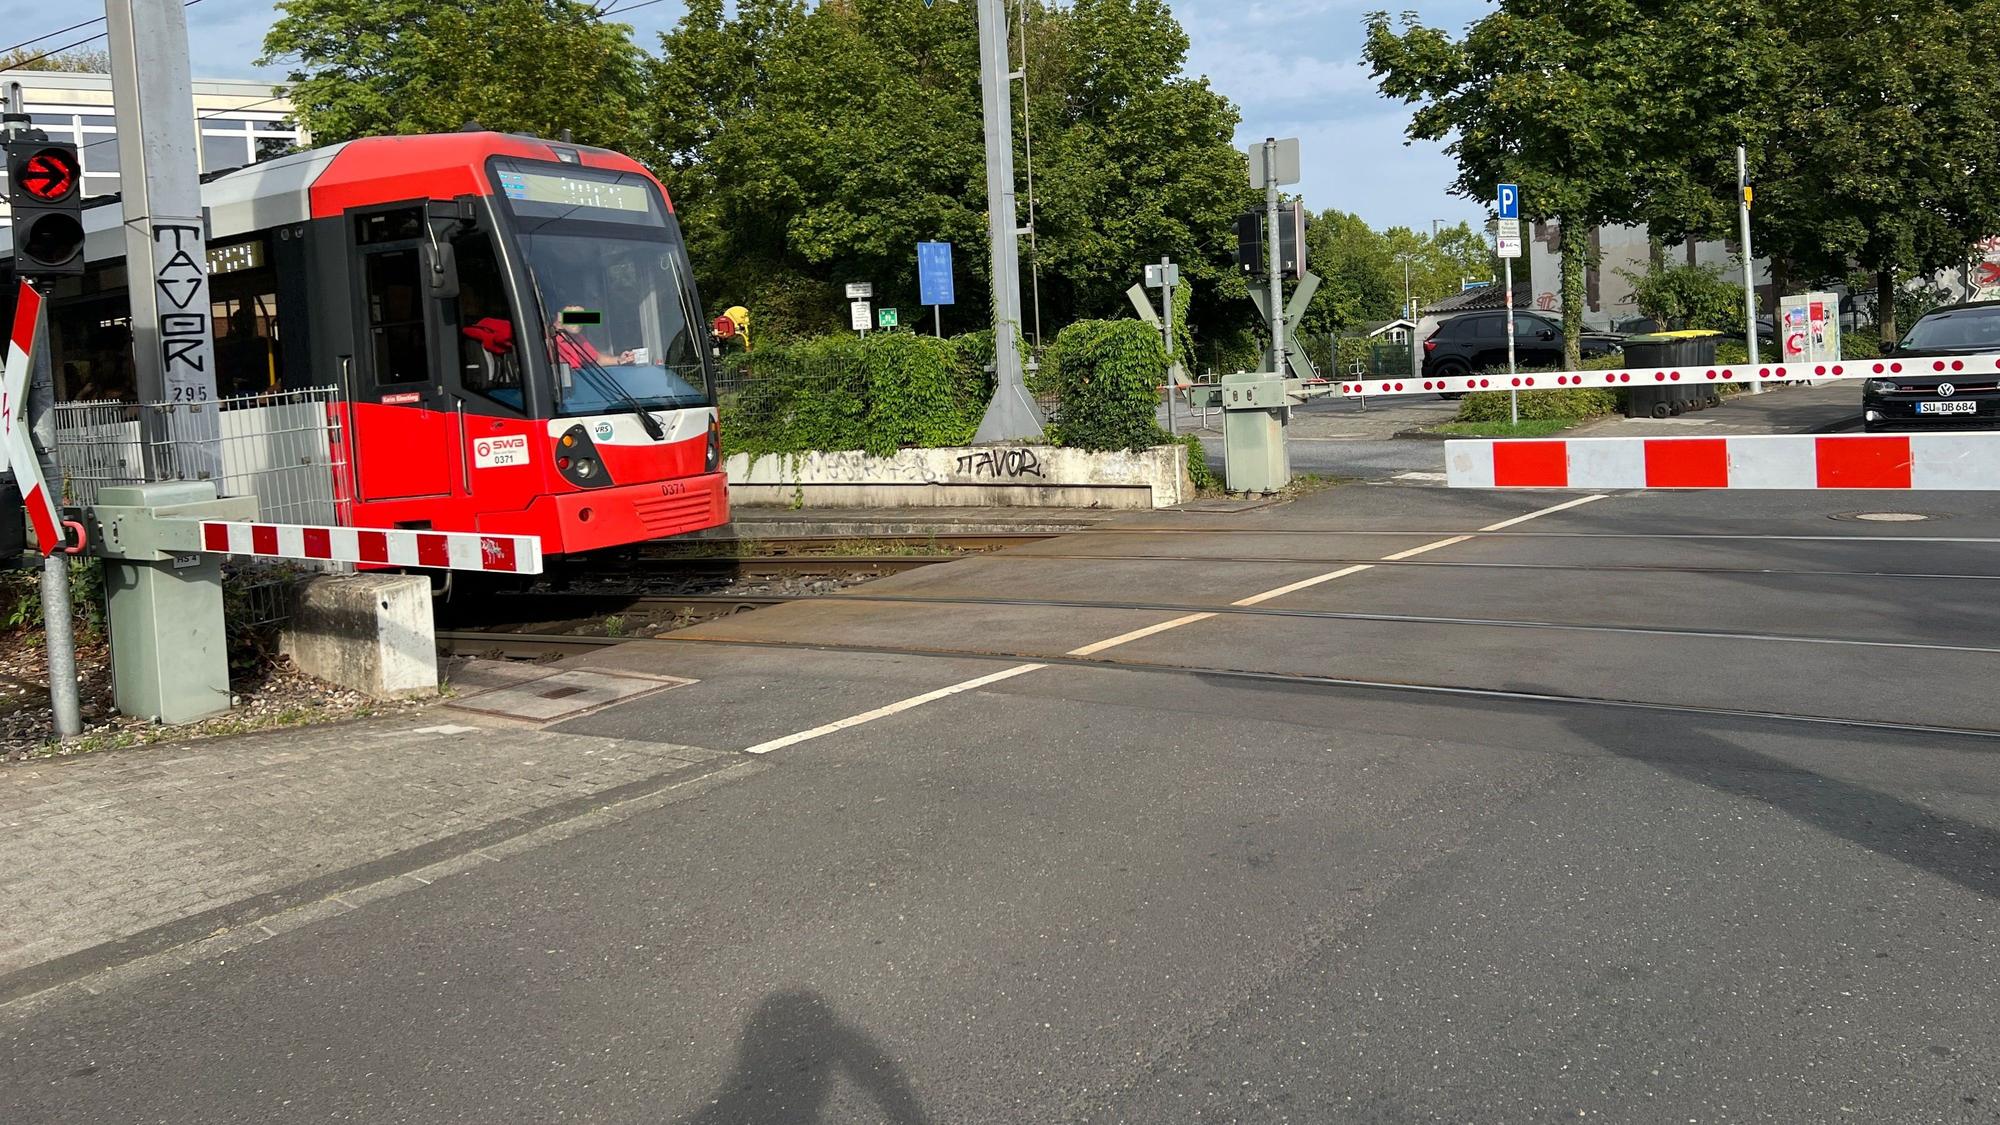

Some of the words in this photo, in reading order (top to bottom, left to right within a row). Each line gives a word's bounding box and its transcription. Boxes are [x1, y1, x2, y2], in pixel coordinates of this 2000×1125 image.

[1502, 188, 1514, 215] P
[173, 386, 207, 402] 295
[1922, 403, 1936, 412] SU
[1941, 403, 1954, 412] DB
[1955, 402, 1975, 411] 684
[594, 425, 609, 433] VRS
[492, 438, 525, 450] SWB
[494, 455, 514, 465] 0371
[661, 483, 686, 497] 0371
